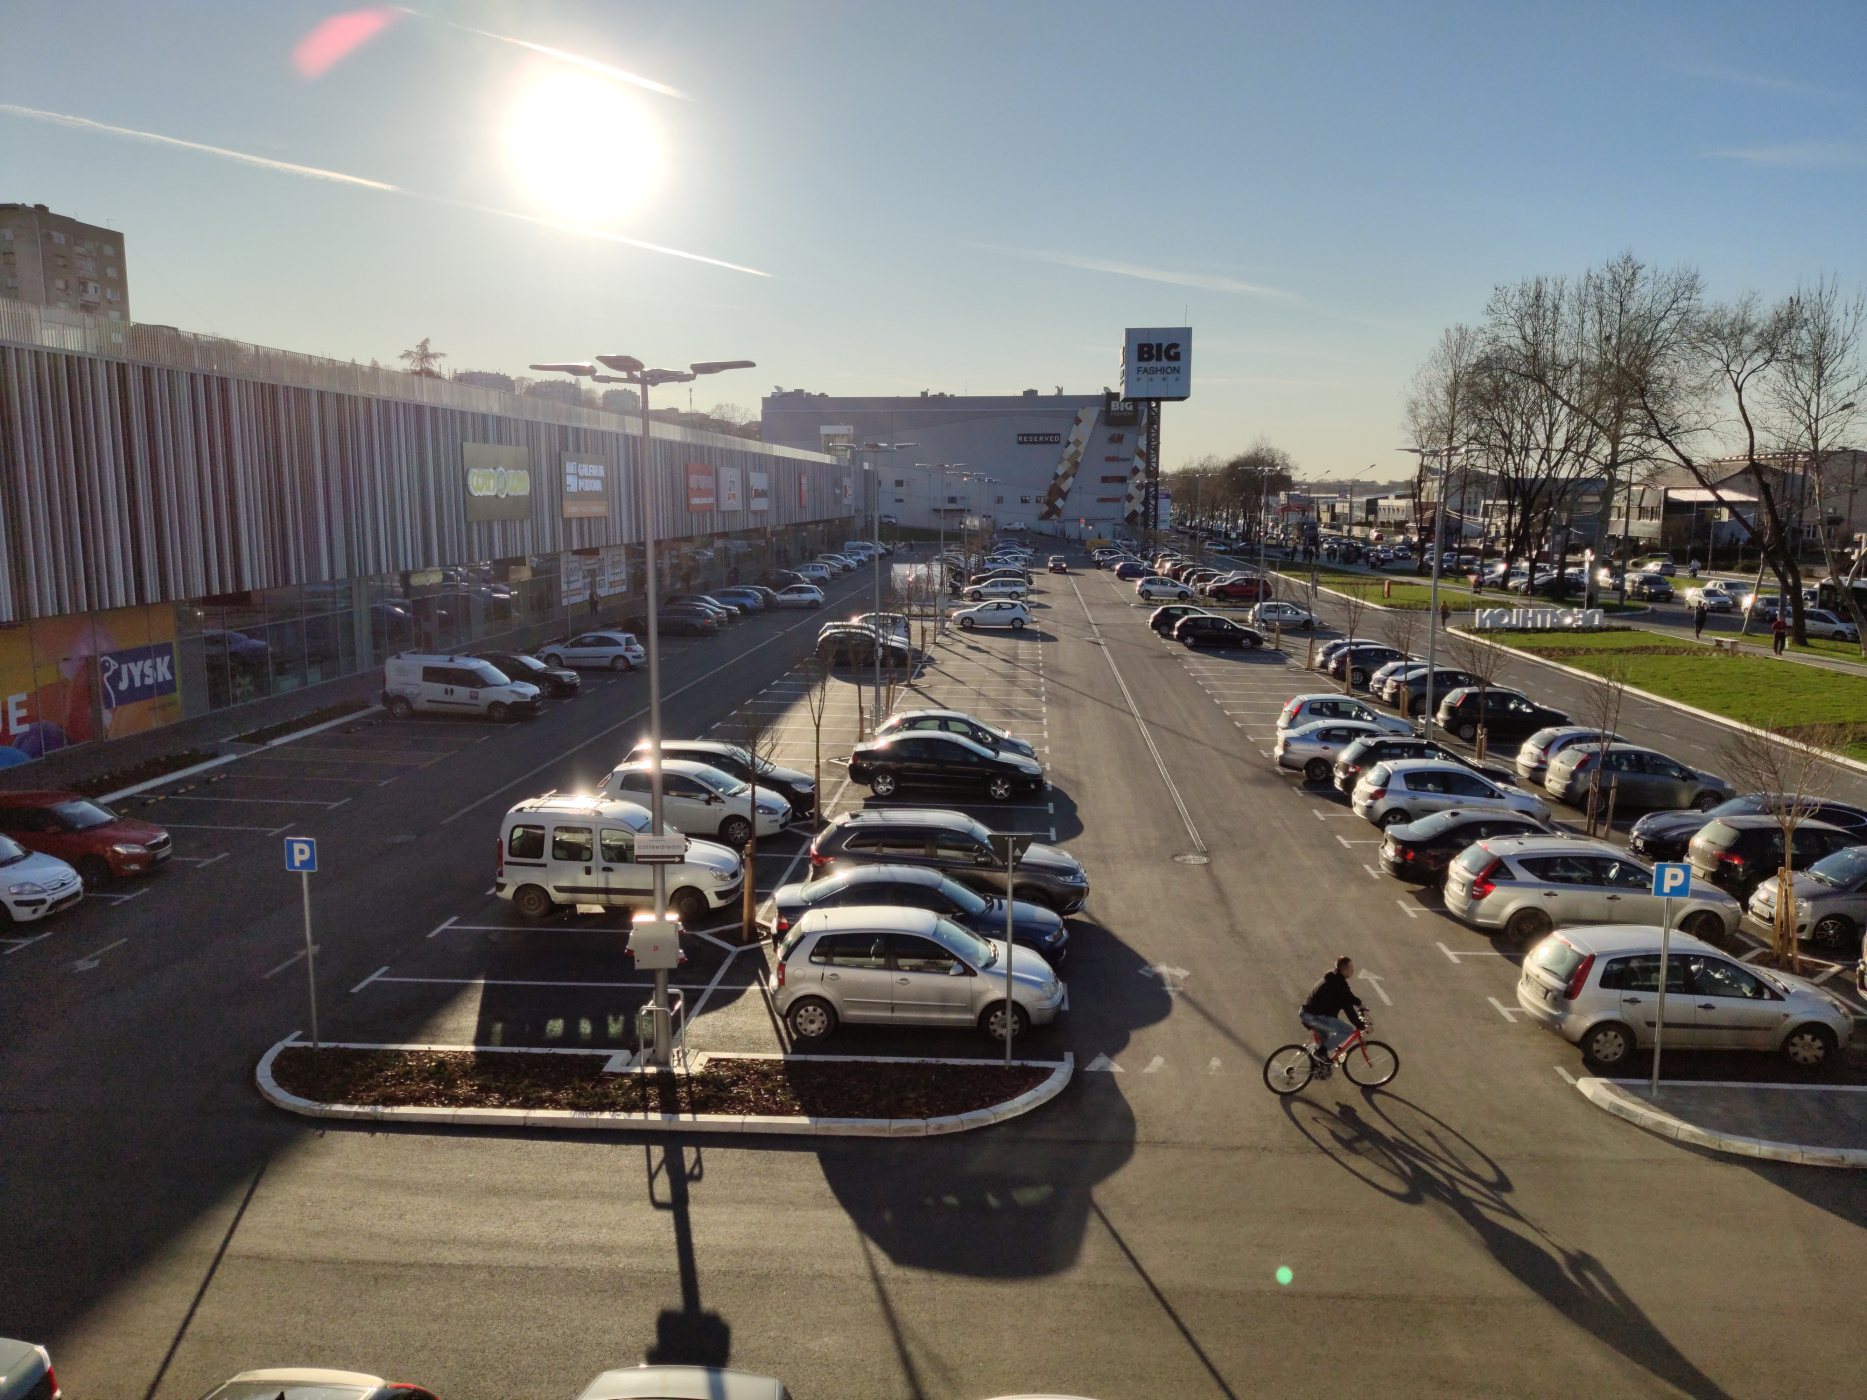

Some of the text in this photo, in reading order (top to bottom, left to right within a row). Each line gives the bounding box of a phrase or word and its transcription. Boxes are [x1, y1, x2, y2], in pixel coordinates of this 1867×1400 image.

[1137, 342, 1181, 362] BIG
[1137, 366, 1180, 375] FASHION
[1111, 401, 1134, 411] BIG
[119, 655, 173, 691] JYSK
[293, 842, 310, 867] P
[1663, 867, 1685, 893] P
